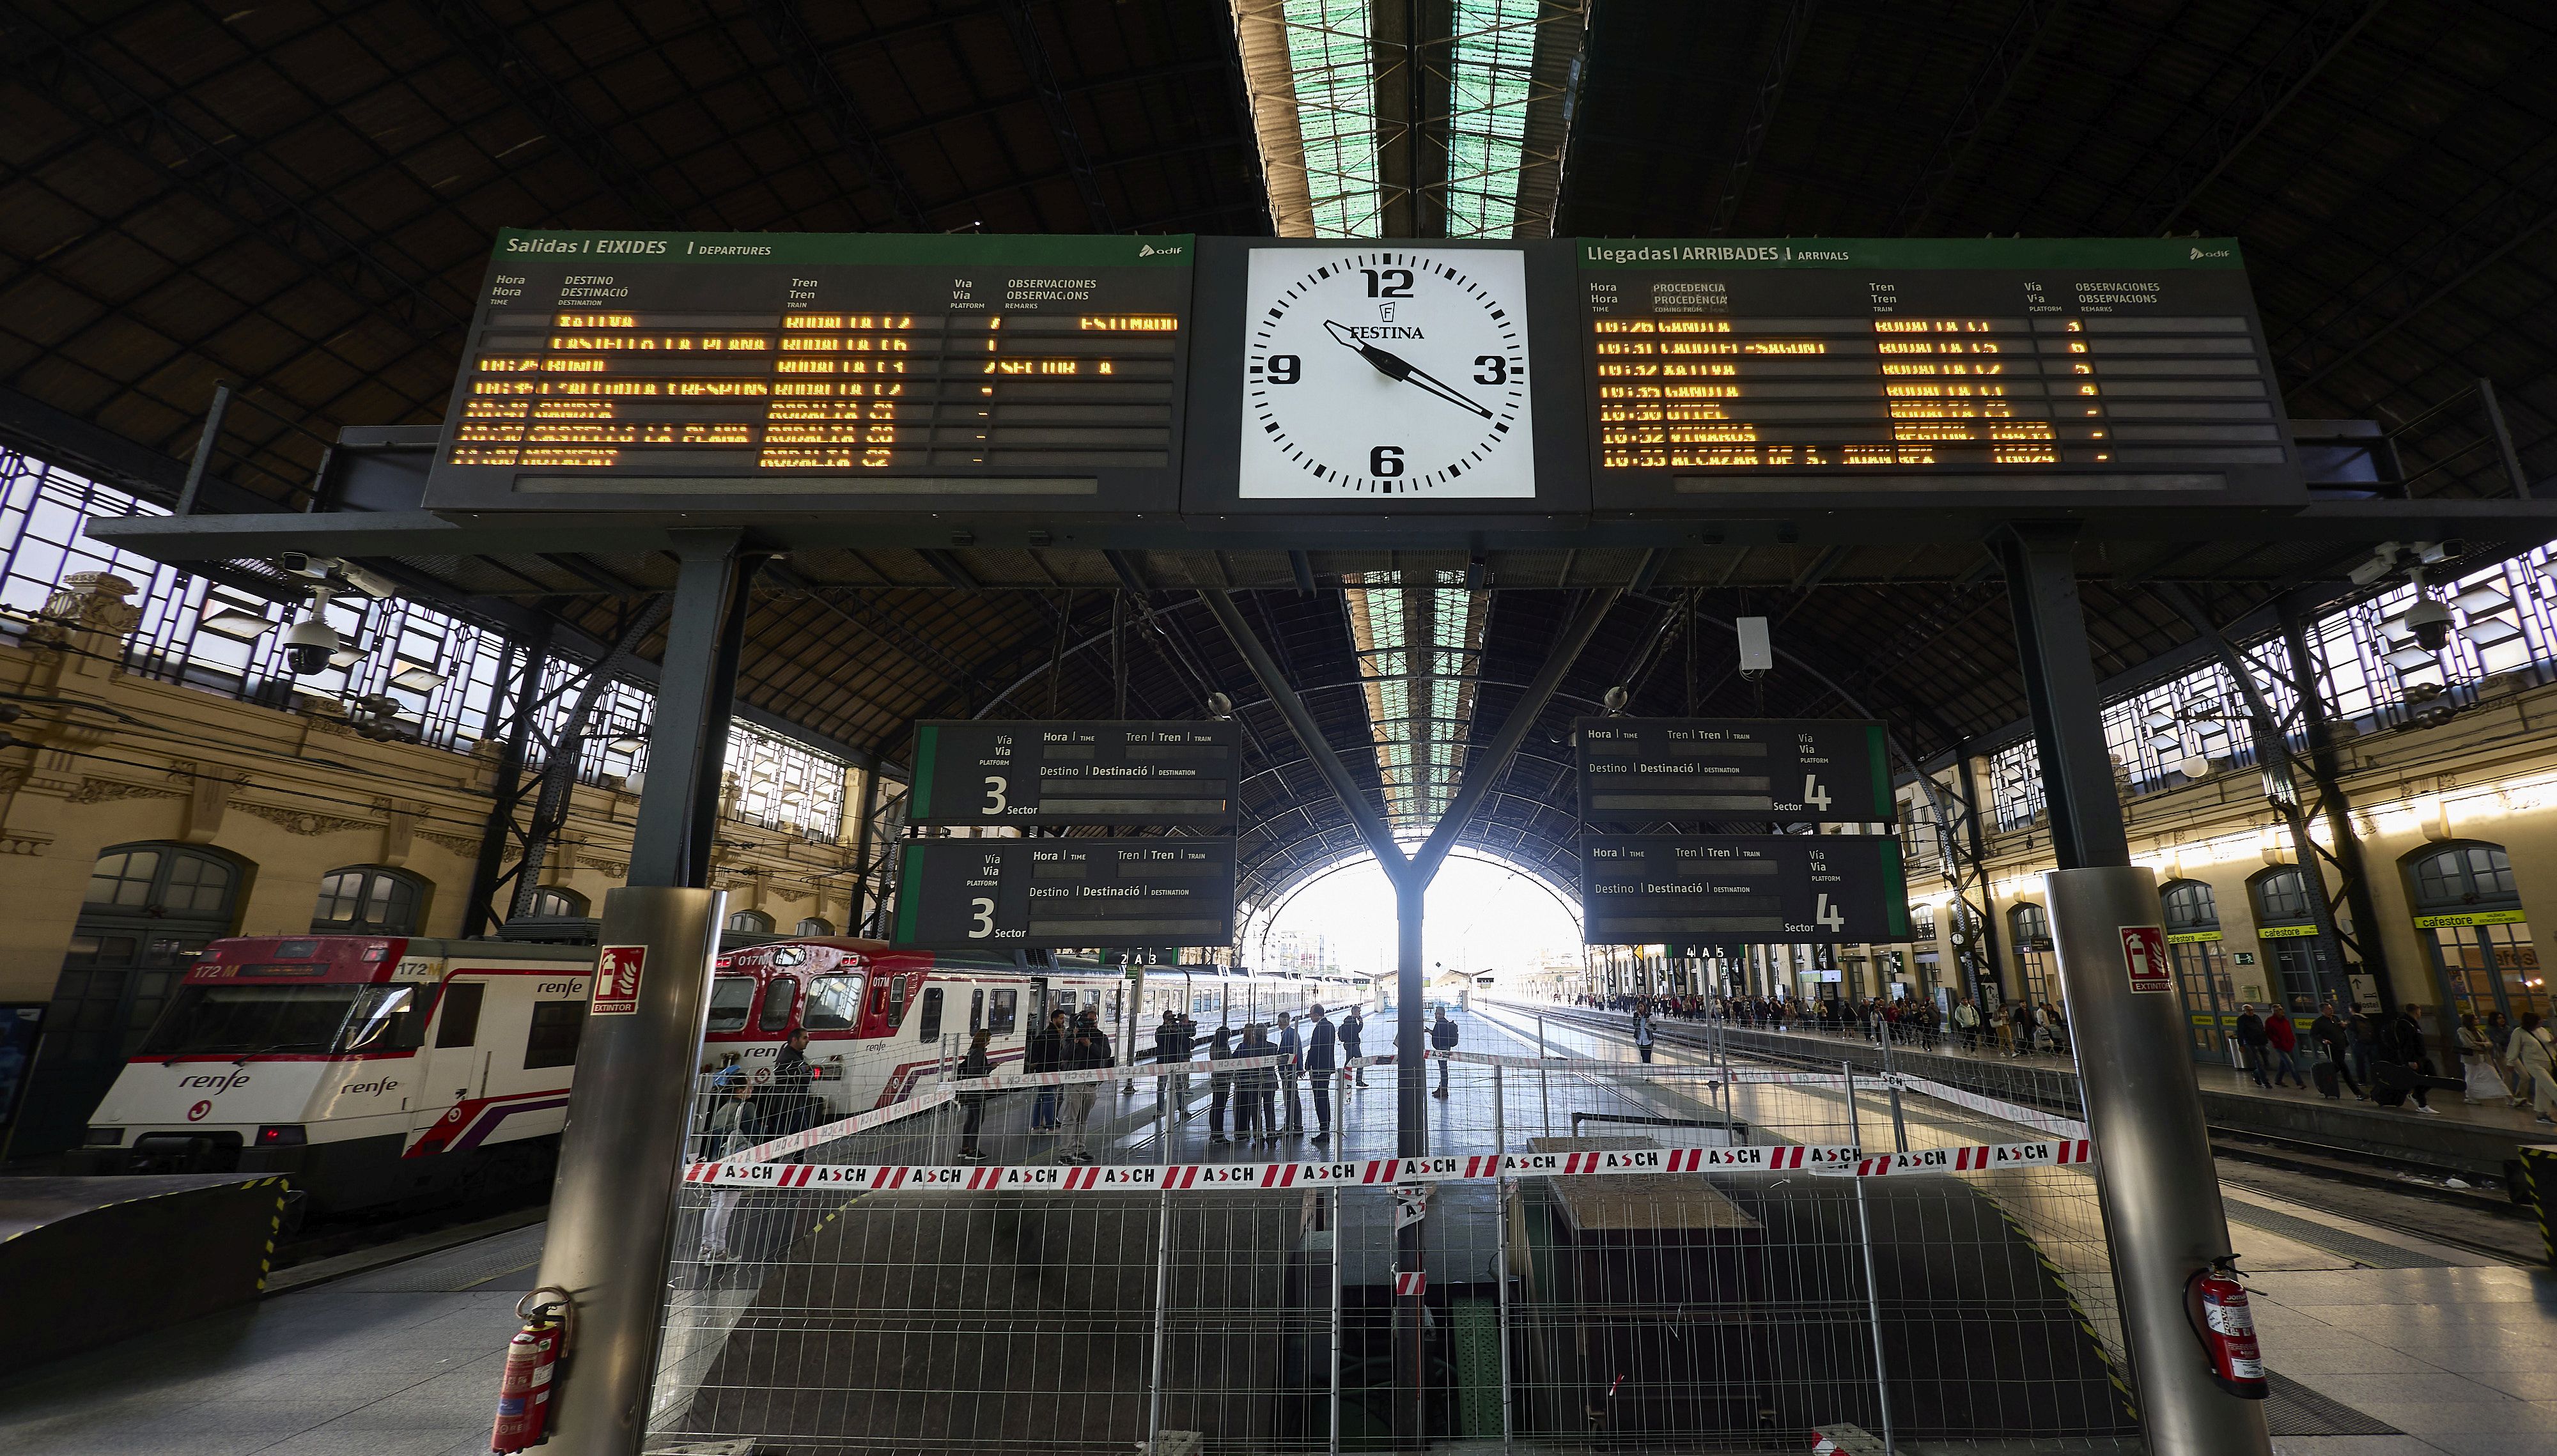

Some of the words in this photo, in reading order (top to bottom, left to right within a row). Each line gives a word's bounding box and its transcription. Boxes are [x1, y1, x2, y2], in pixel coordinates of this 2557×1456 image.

[507, 238, 577, 252] Salidas
[596, 240, 667, 253] EIXIDES
[699, 247, 771, 255] DEPARTURES
[1589, 247, 1671, 263] Llegadas
[1683, 247, 1778, 259] ARRIBADES
[497, 275, 525, 284] Hora
[565, 276, 613, 284] DESTINO
[1009, 279, 1096, 288] OBSERVACIONES
[1360, 270, 1414, 297] 12
[493, 287, 521, 295] Hora
[561, 287, 628, 297] DESTINACIÓ
[2025, 282, 2042, 291] Vía
[789, 290, 814, 298] Tren
[953, 291, 970, 299] Via
[1350, 327, 1424, 339] FESTINA
[1267, 355, 1300, 384] 9
[1473, 355, 1506, 385] 3
[1370, 446, 1404, 477] 6
[997, 735, 1011, 744] Vía
[1798, 734, 1812, 742] Vía
[995, 747, 1010, 755] Via
[1799, 745, 1814, 753] Via
[1041, 767, 1078, 775] Destino
[1093, 766, 1147, 775] Destinació
[1590, 764, 1626, 772] Destino
[1641, 764, 1693, 772] Destinació
[982, 777, 1007, 814] 3
[1805, 775, 1831, 811] 4
[1007, 806, 1038, 814] Sector
[1151, 851, 1174, 859] Tren
[1594, 848, 1617, 856] Hora
[1675, 848, 1696, 856] Tren
[1707, 848, 1730, 856] Tren
[1810, 850, 1824, 859] Vía
[986, 854, 1000, 864] Vía
[983, 866, 999, 875] Via
[1810, 862, 1826, 871] Via
[1030, 887, 1069, 896] Destino
[1084, 886, 1139, 895] Destinació
[1596, 884, 1633, 893] Destino
[1648, 883, 1702, 892] Destinació
[968, 898, 995, 938] 3
[1817, 894, 1844, 932] 4
[2423, 916, 2473, 927] cafestore
[995, 929, 1026, 938] Sector
[2265, 928, 2299, 938] cafestore
[1687, 947, 1694, 957] 4
[1702, 947, 1709, 957] A
[1718, 947, 1724, 957] 5
[1121, 954, 1127, 964] 2
[1135, 954, 1142, 964] A
[194, 966, 220, 977] 172
[873, 977, 890, 987] 017M
[538, 978, 582, 998] renfe
[866, 1040, 886, 1051] renfe
[743, 1047, 778, 1061] ren
[179, 1069, 250, 1095] renfe
[341, 1076, 398, 1096] renfe
[1709, 1149, 1760, 1164] ASCH
[1812, 1147, 1861, 1162] ASCH
[1997, 1144, 2048, 1161] ASCH
[1505, 1156, 1556, 1170] ASCH
[1606, 1152, 1658, 1167] ASCH
[1898, 1151, 1947, 1167] ASCH
[726, 1165, 772, 1179] ASCH
[1304, 1164, 1355, 1179] ASCH
[1405, 1159, 1456, 1175] ASCH
[818, 1168, 866, 1182] ASCH
[912, 1169, 960, 1182] ASCH
[1008, 1169, 1057, 1182] ASCH
[1105, 1168, 1154, 1182] ASCH
[1204, 1167, 1254, 1182] ASCH
